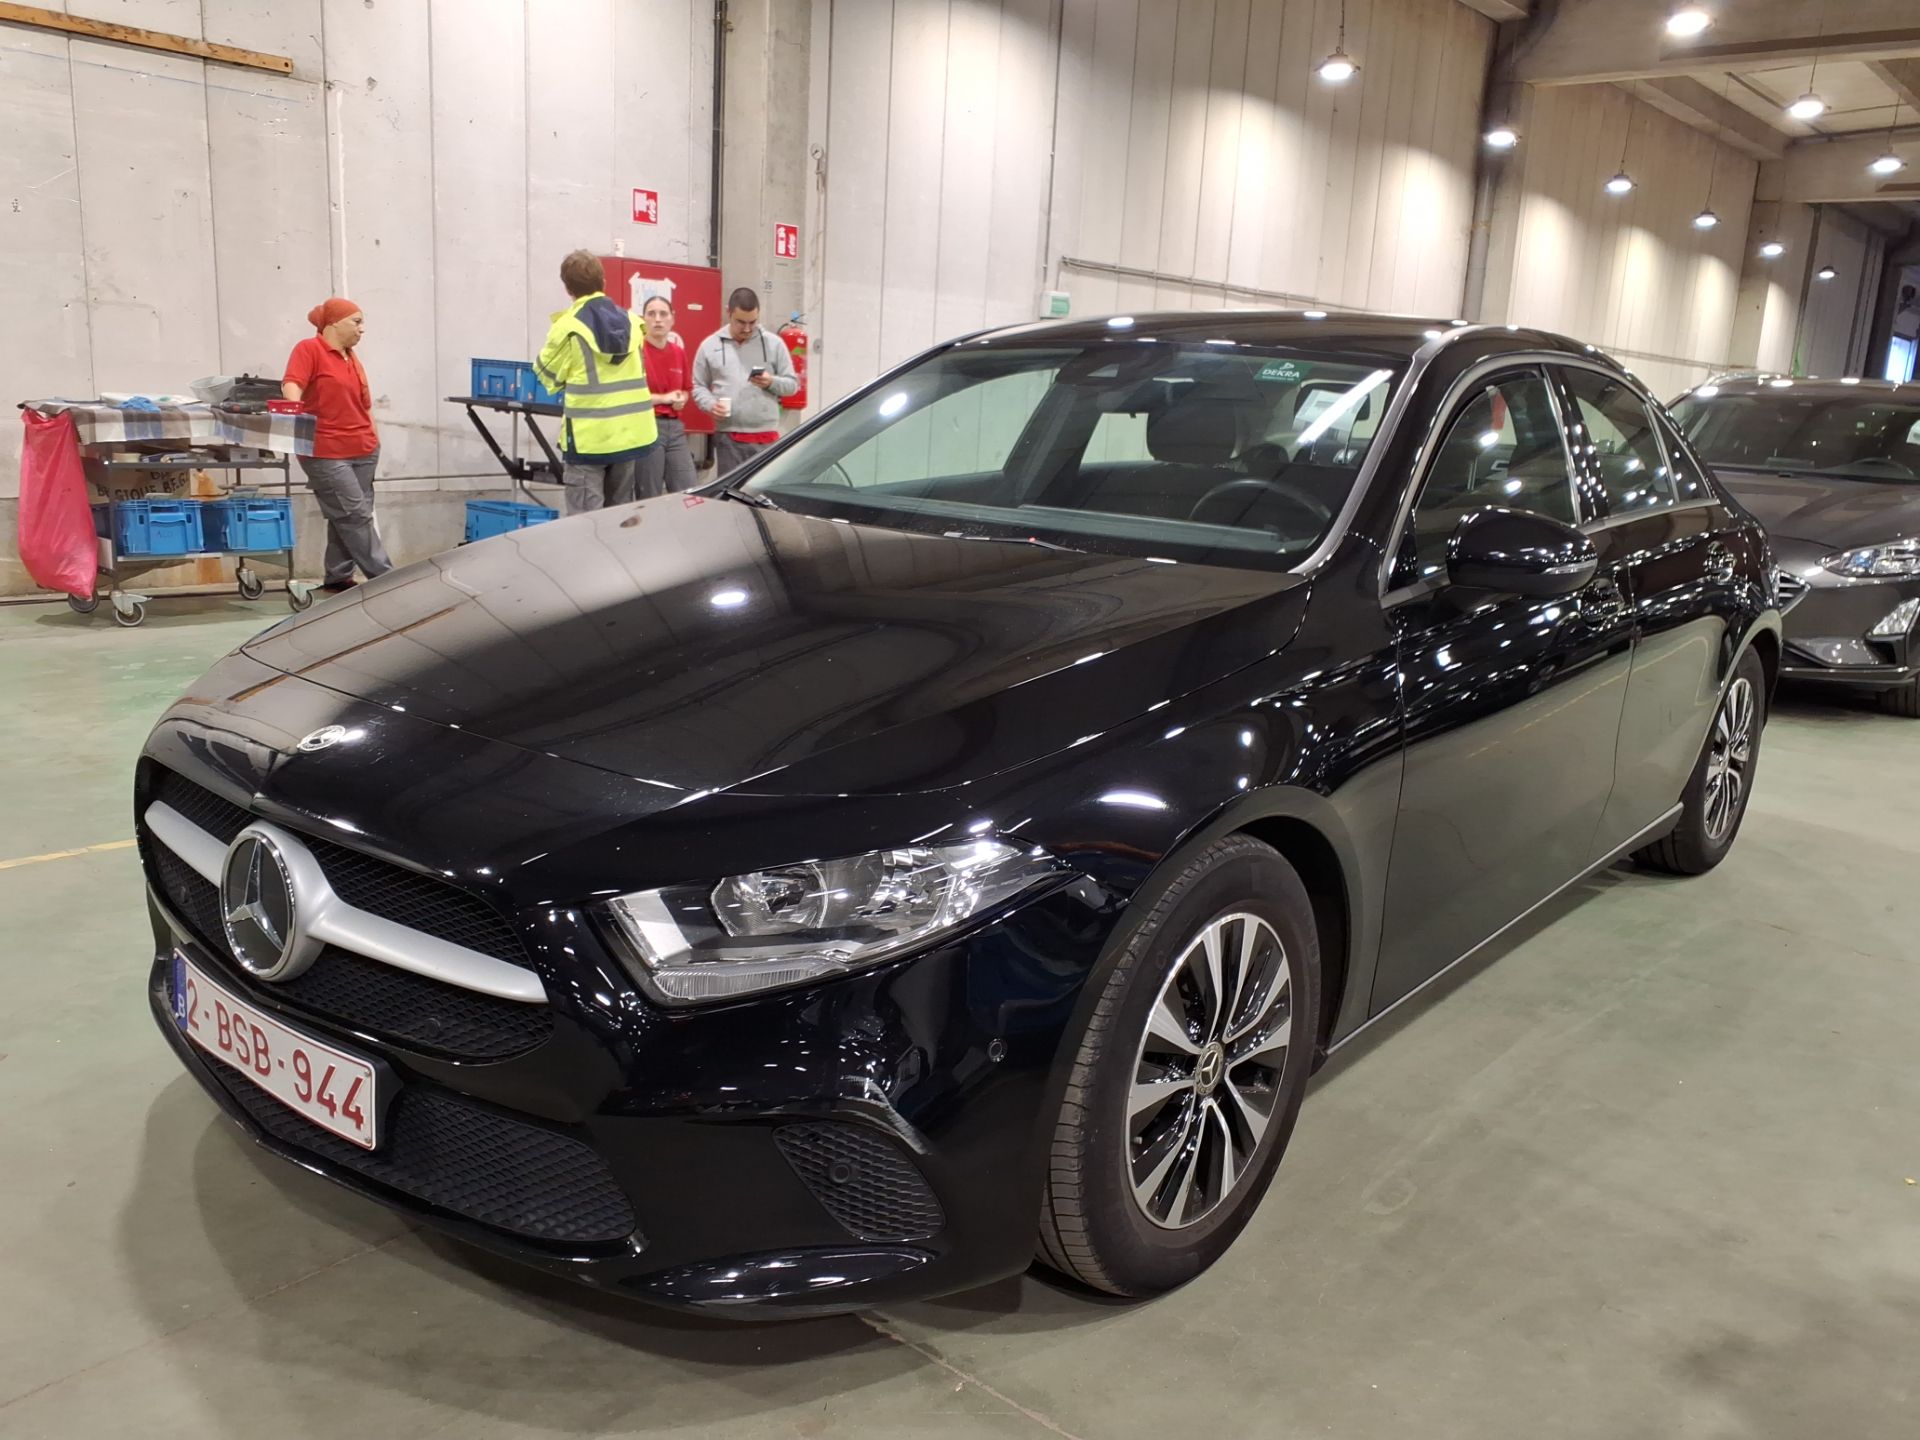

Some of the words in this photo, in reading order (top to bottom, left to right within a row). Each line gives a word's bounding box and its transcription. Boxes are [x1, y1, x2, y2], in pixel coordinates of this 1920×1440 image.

[1262, 368, 1300, 378] DEKRA
[178, 994, 187, 1018] B
[187, 978, 365, 1131] 2-BSB-944
